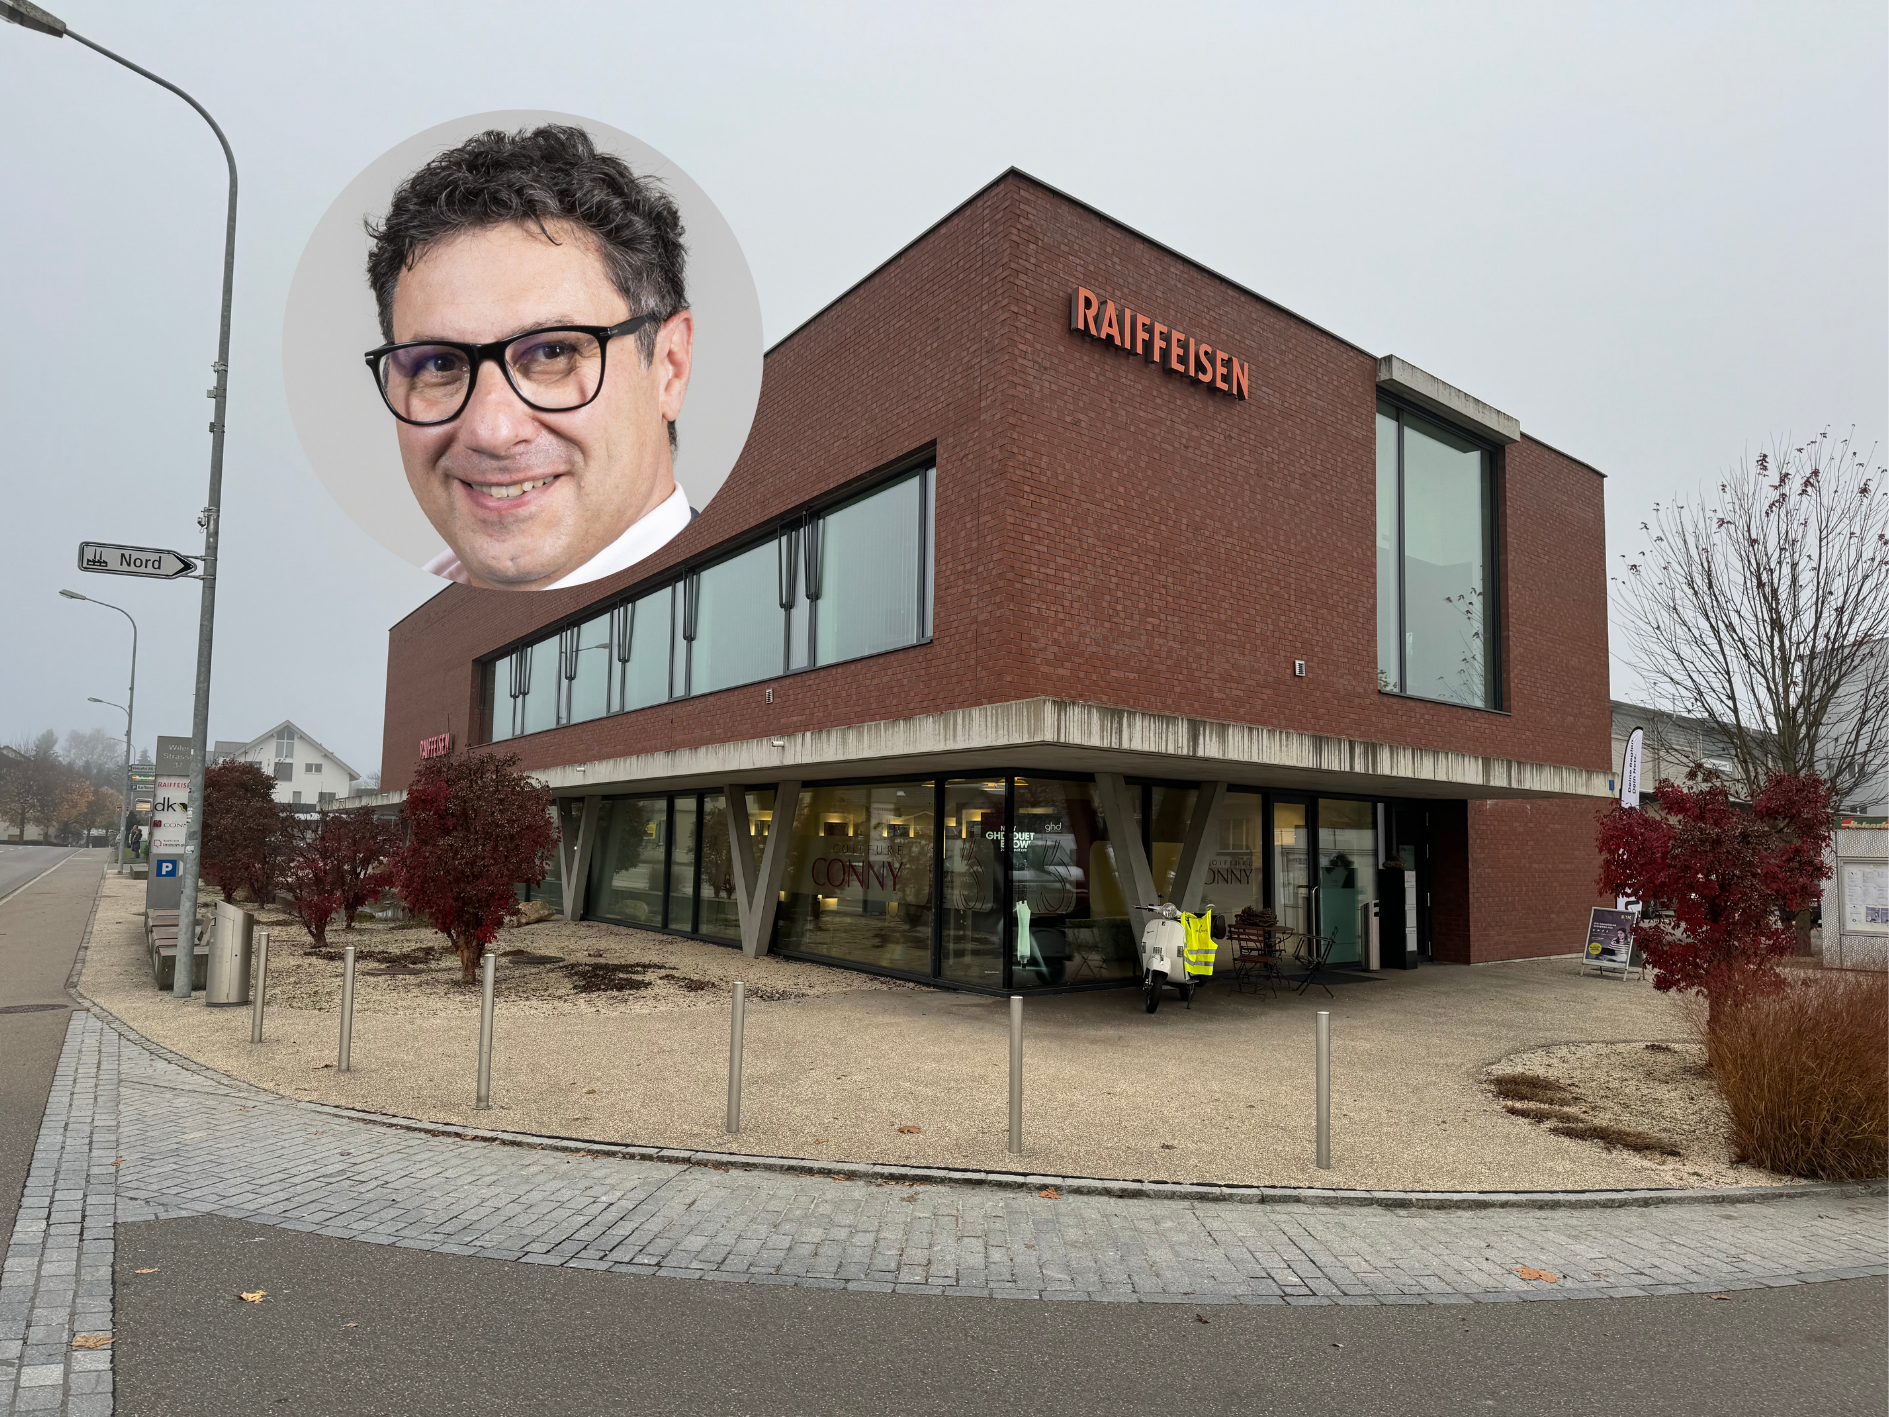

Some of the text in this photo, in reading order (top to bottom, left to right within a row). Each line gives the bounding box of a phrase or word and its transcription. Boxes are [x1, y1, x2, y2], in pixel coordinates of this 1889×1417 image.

[1076, 286, 1249, 400] RAIFFEISEN
[120, 552, 162, 571] Nord
[154, 797, 176, 812] dk
[1044, 822, 1062, 833] ghd
[832, 843, 904, 856] COIFFURE
[161, 862, 173, 875] P
[811, 857, 904, 892] CONNY
[1204, 868, 1253, 885] ONNY
